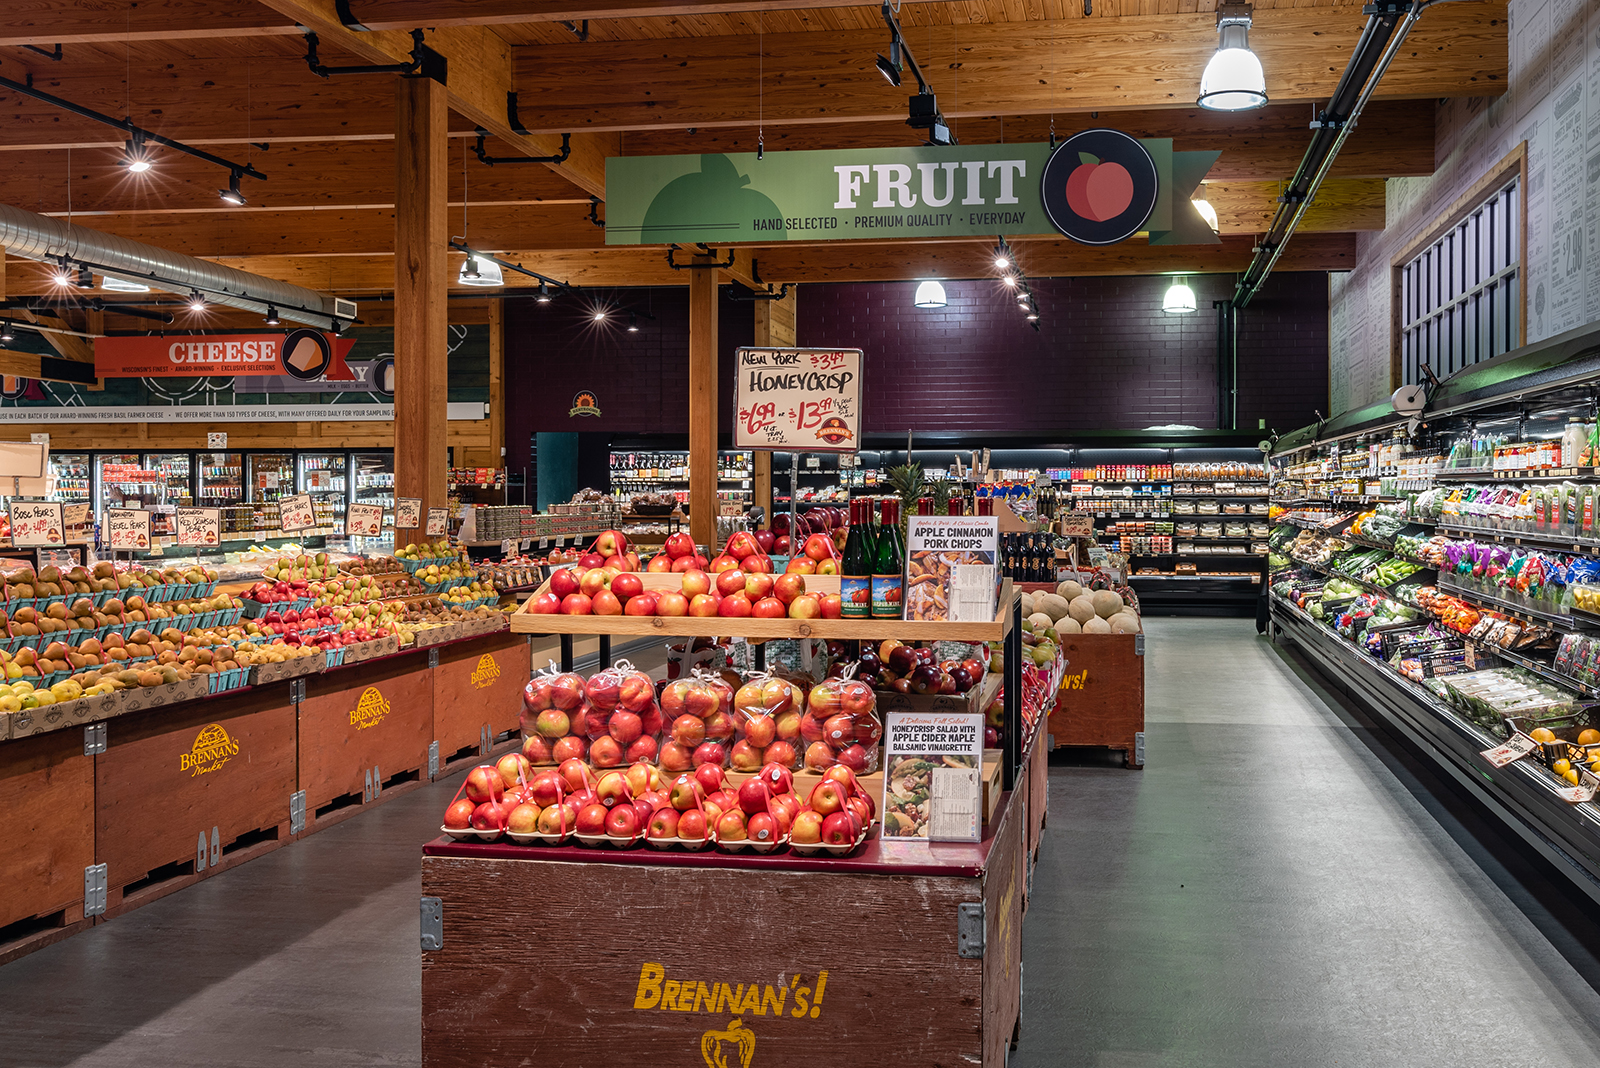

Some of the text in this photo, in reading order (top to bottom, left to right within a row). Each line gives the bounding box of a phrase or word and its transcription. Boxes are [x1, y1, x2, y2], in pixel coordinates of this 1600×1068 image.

[833, 160, 1026, 209] FRUIT
[753, 212, 1026, 230] HAND SELECTED PREMIUM QUALITY EVERYDAY
[168, 342, 276, 364] CHEESE
[742, 350, 768, 366] NEW
[772, 351, 802, 366] YORK
[749, 371, 853, 394] HONEYCRISP
[33, 506, 55, 517] PEARS
[130, 520, 146, 530] PEARS
[180, 518, 191, 526] RED
[914, 528, 993, 537] APPLE CINNAMON
[924, 539, 982, 548] PORK CHOPS
[349, 698, 390, 725] BRENNAN'S
[893, 734, 975, 742] APPLE CIDER MAPLE
[180, 736, 239, 771] BRENNAN'S
[191, 757, 231, 777] Market
[633, 962, 829, 1019] BRENNAN'S!
